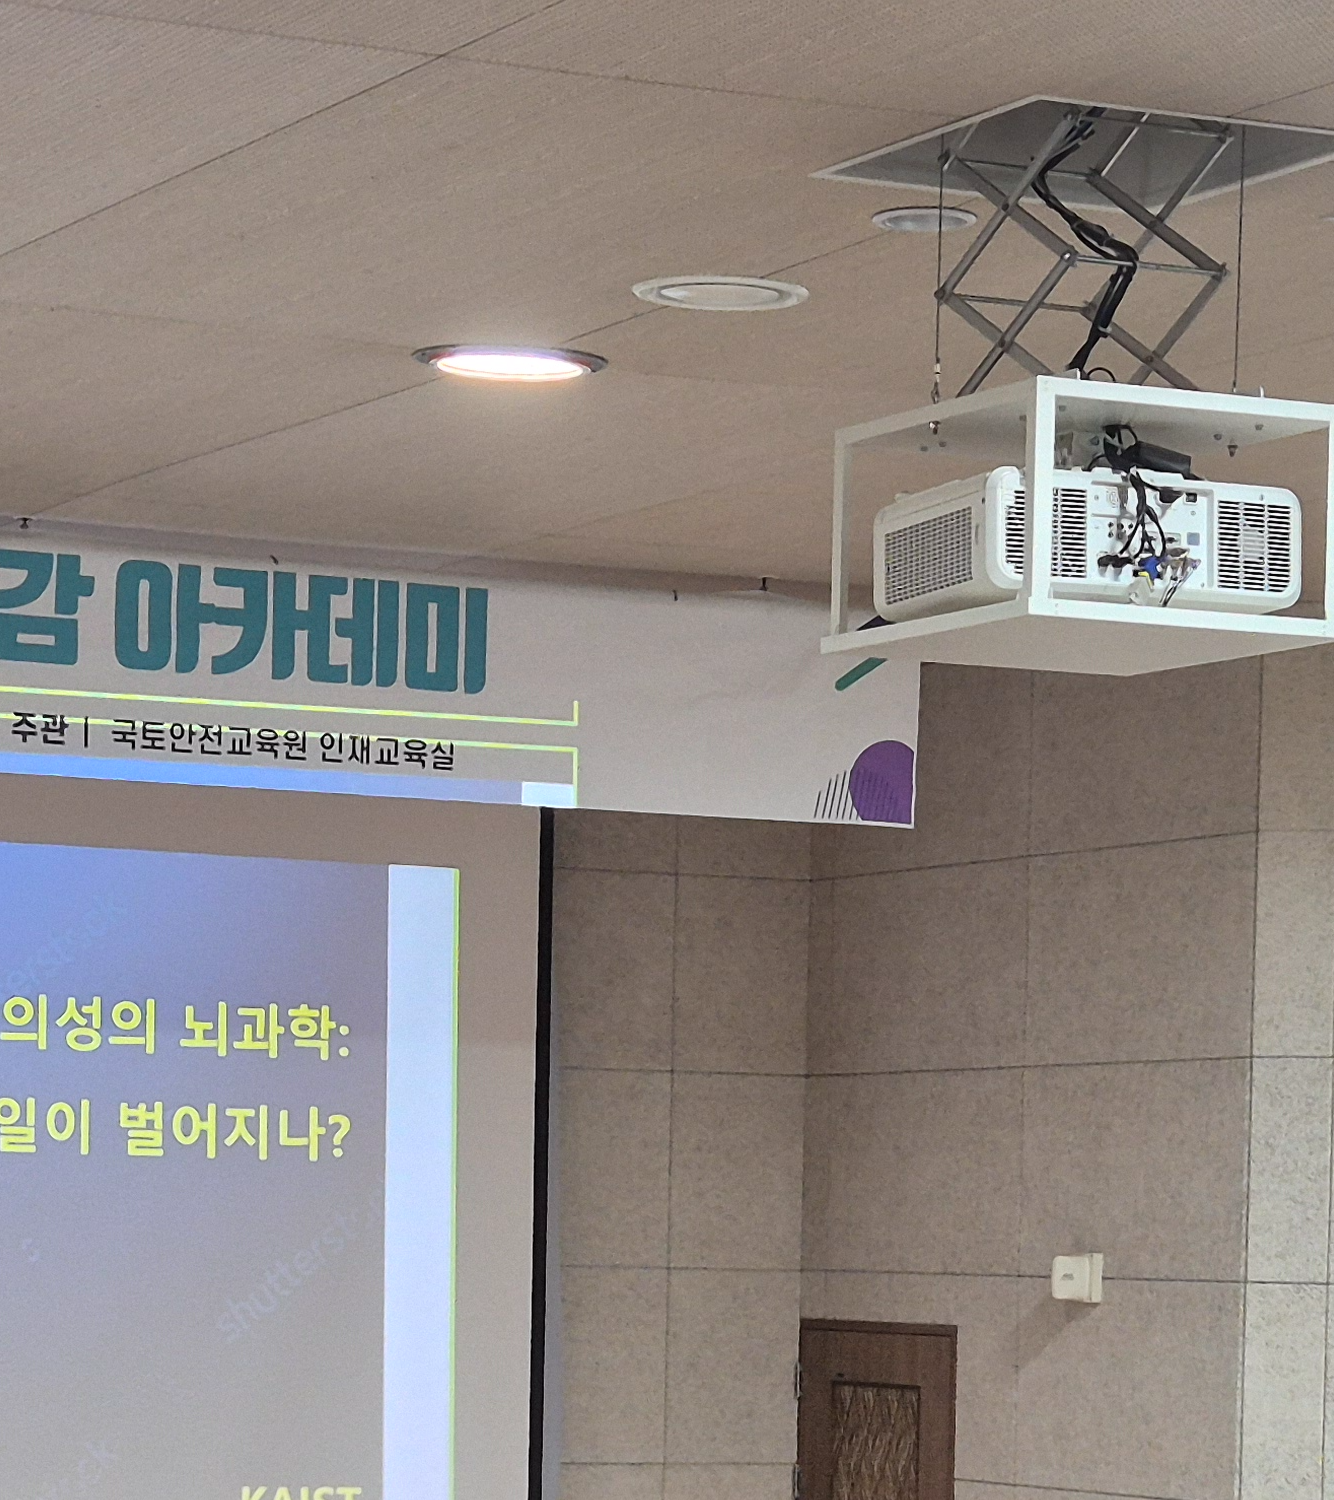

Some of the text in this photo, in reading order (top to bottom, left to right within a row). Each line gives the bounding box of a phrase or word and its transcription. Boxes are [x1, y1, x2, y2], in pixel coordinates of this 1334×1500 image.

[114, 558, 488, 695] 아카데미
[10, 710, 71, 747] 주관
[111, 718, 309, 762] 국토안전교육원
[318, 730, 456, 772] 인재교육실
[179, 1001, 350, 1060] 뇌과학:
[118, 1101, 353, 1162] 벌어지나?
